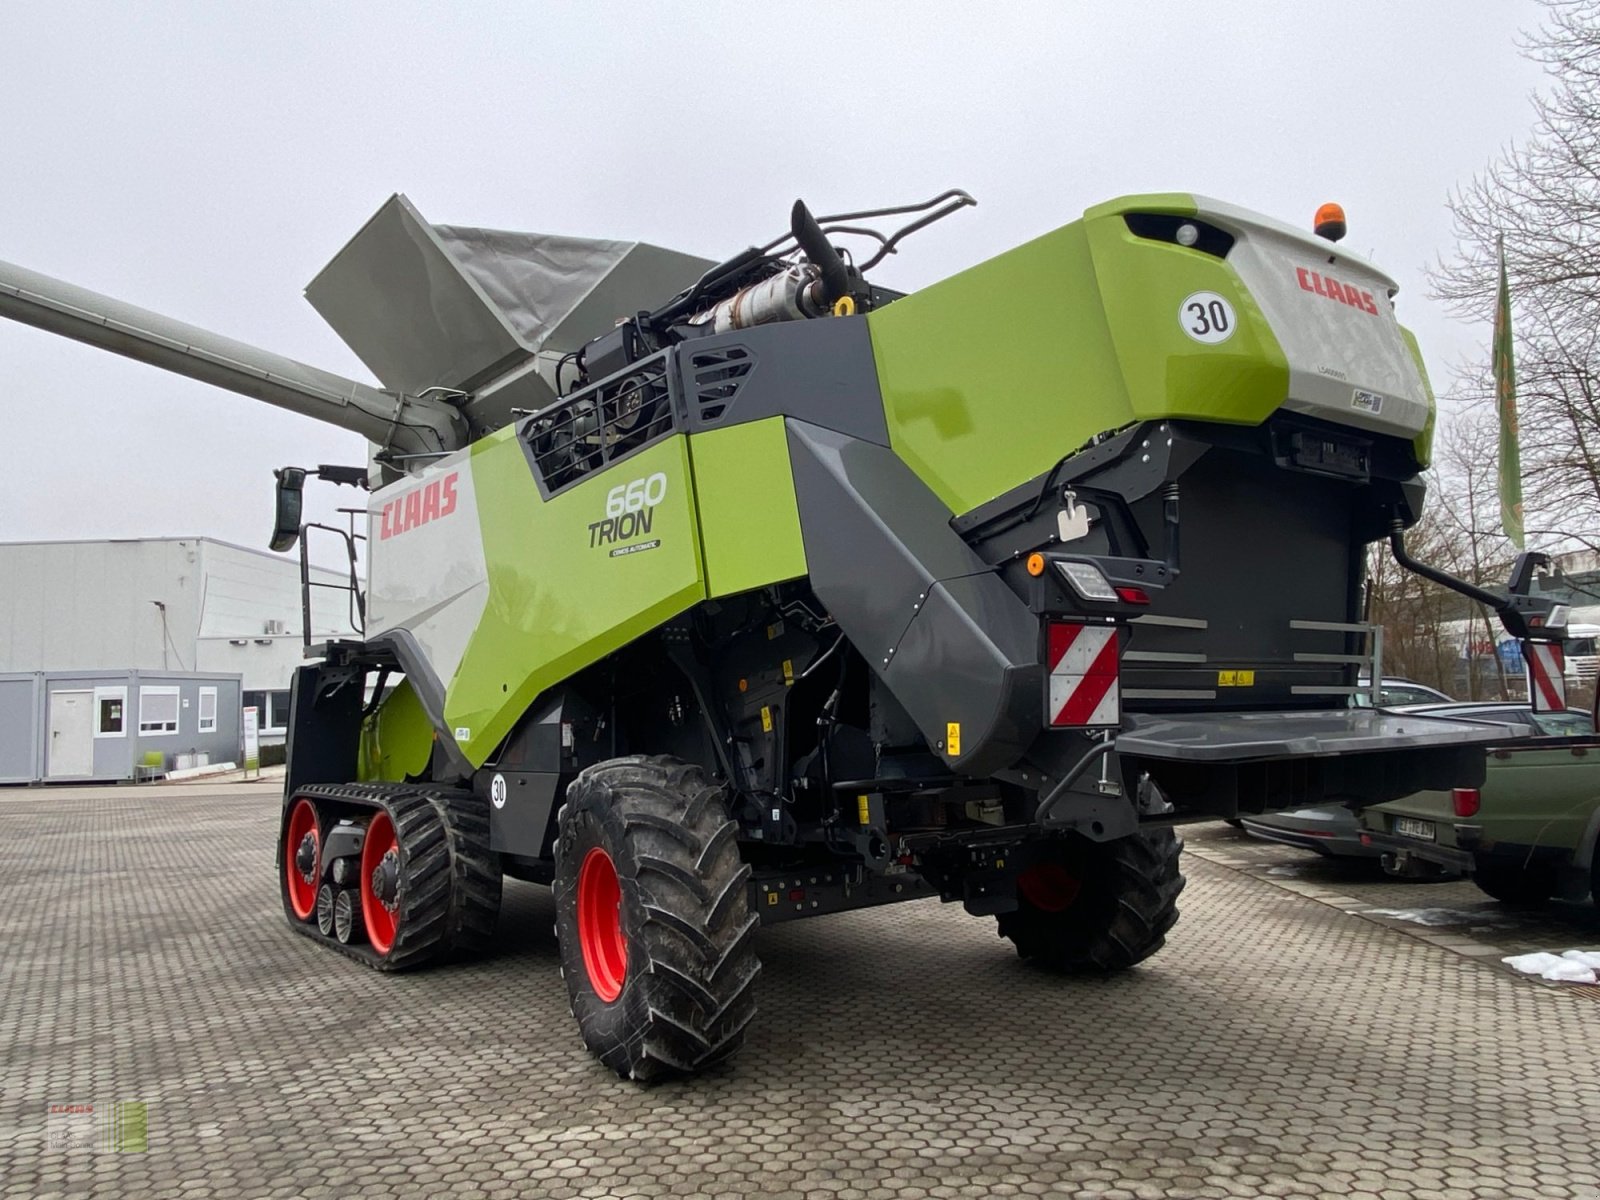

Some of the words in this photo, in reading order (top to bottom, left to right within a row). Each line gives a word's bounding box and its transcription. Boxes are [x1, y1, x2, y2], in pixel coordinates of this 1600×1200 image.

[1296, 266, 1379, 316] CLAAS
[1187, 300, 1229, 336] 30
[380, 471, 459, 541] CLAAS
[606, 472, 667, 519] 660
[588, 506, 654, 549] TRION
[493, 780, 504, 802] 30
